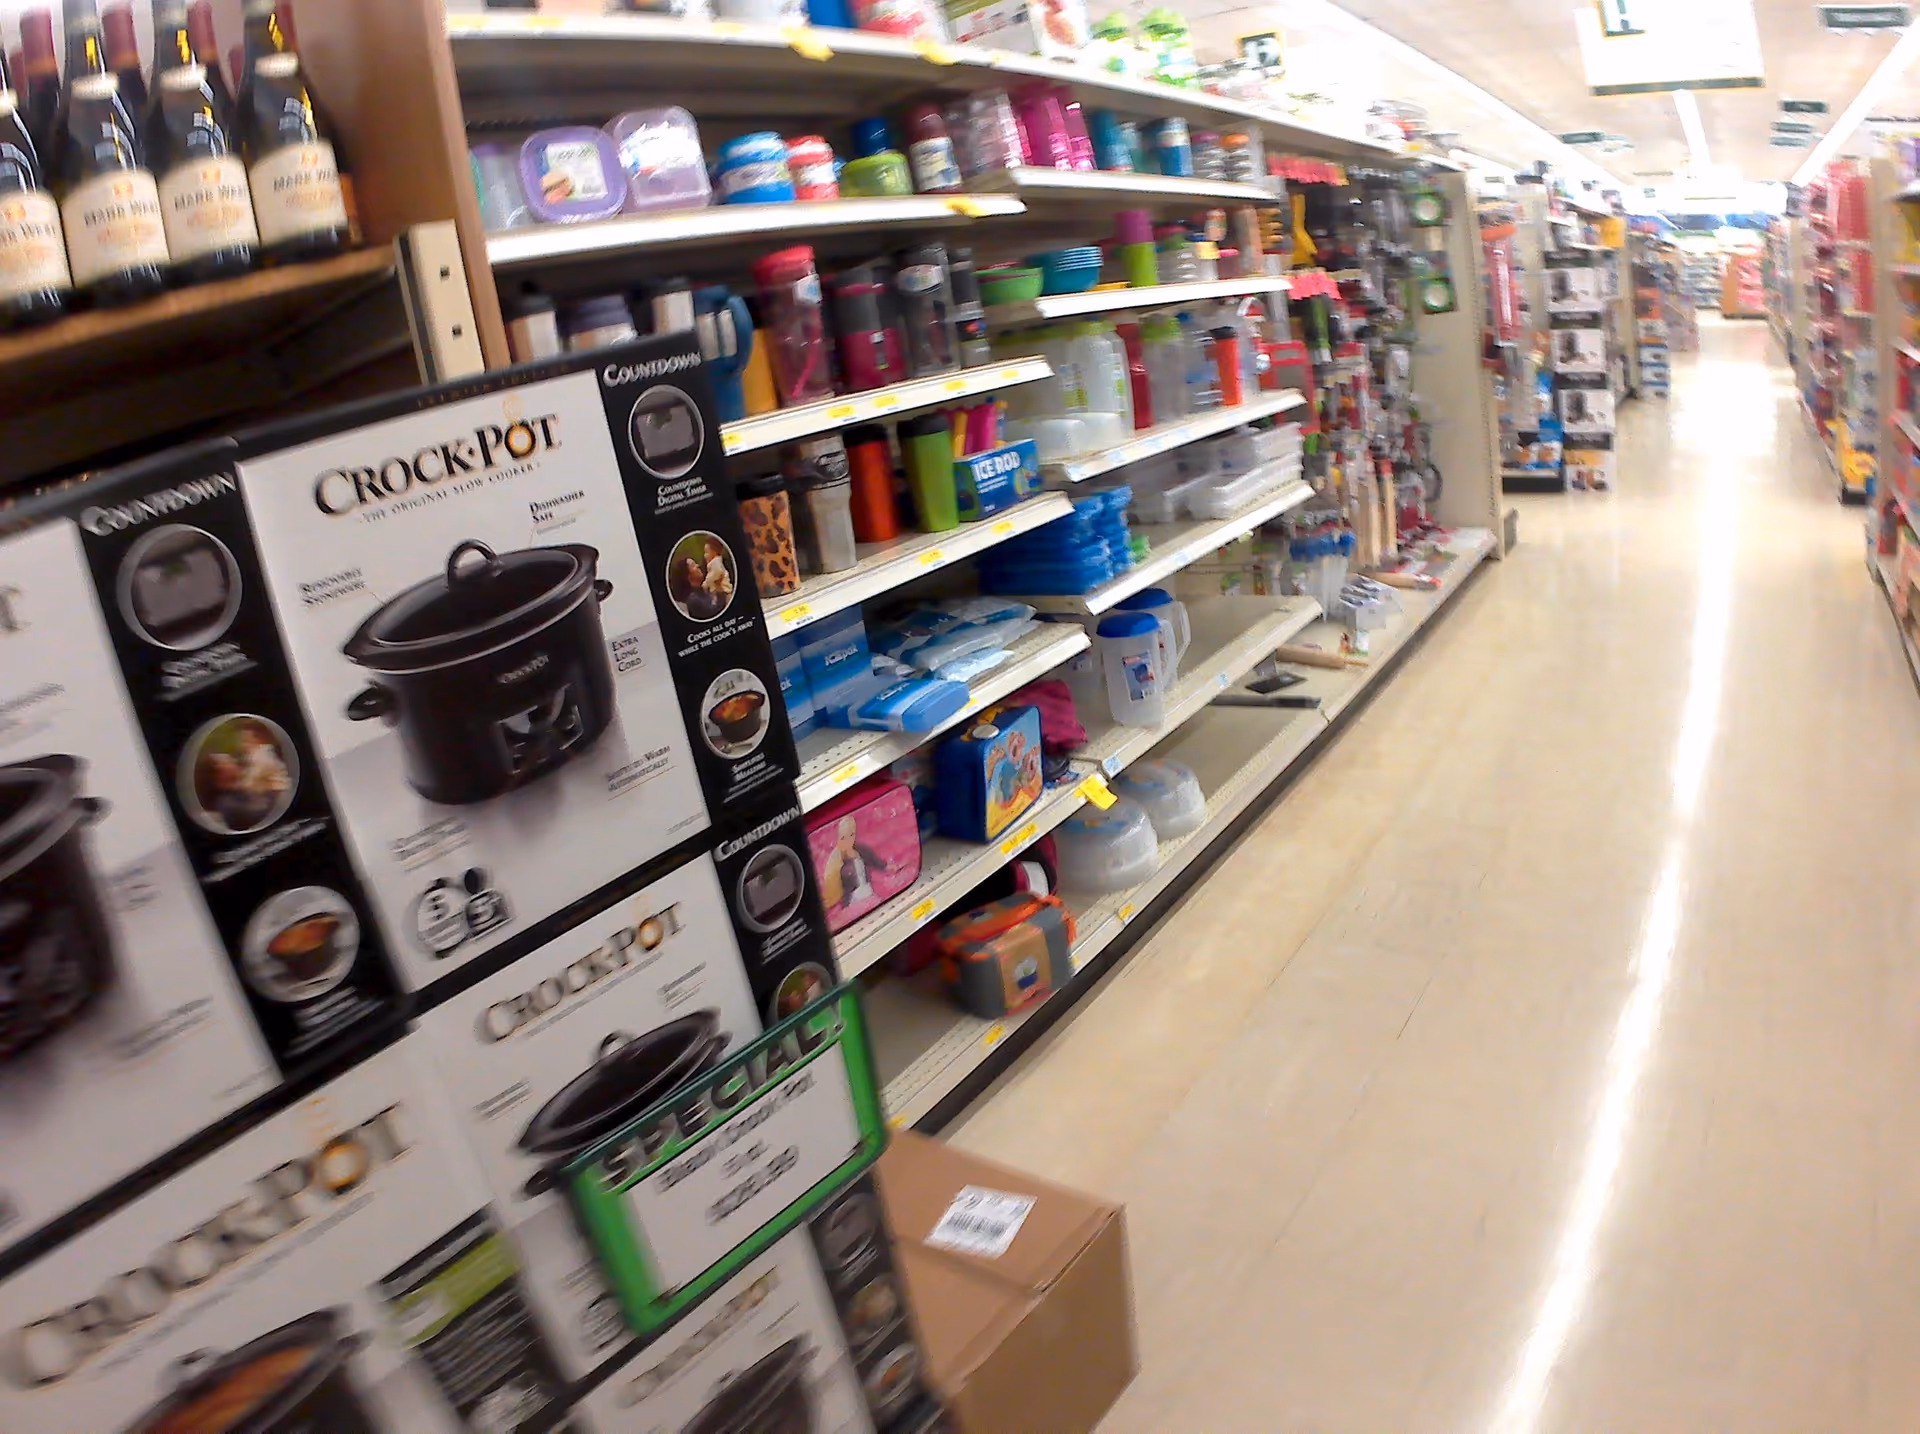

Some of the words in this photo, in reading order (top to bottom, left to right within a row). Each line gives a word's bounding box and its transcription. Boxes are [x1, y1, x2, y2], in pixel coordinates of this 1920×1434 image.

[603, 352, 701, 387] COUNTDOWN
[970, 459, 995, 482] ICE
[612, 636, 639, 652] EXTRA
[687, 628, 712, 643] COOKS
[614, 646, 639, 663] LONG
[618, 657, 643, 673] CORD
[714, 805, 801, 863] COUNTDOWN
